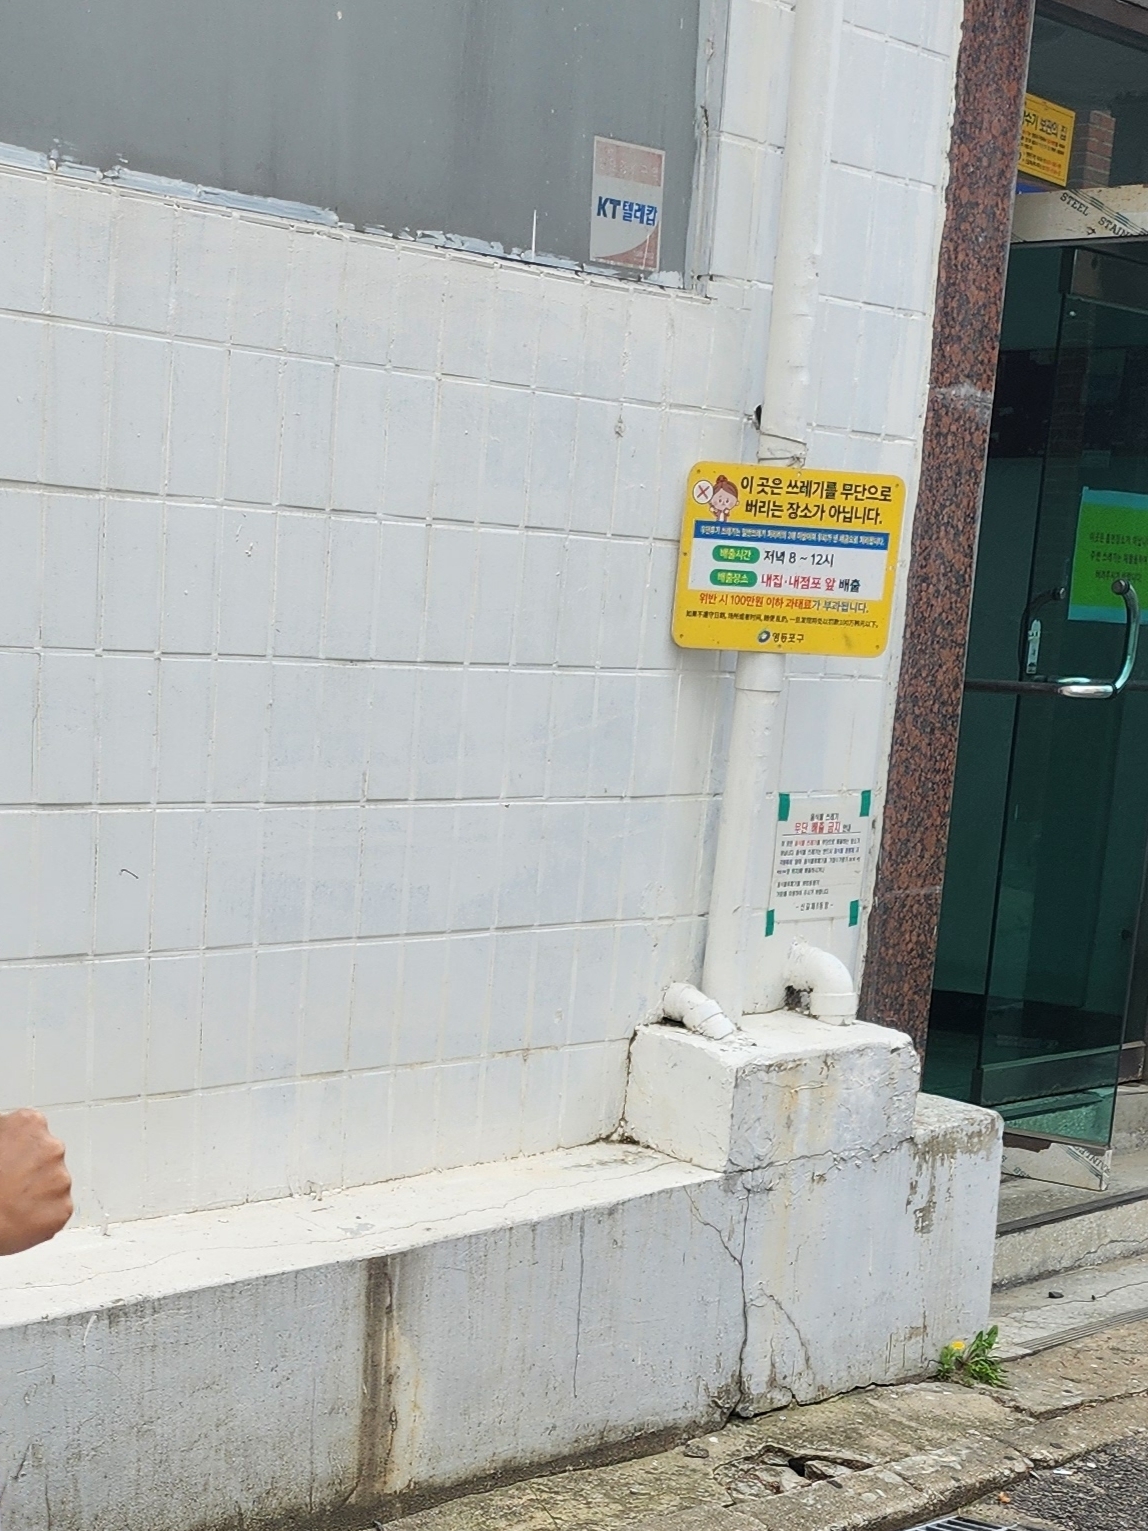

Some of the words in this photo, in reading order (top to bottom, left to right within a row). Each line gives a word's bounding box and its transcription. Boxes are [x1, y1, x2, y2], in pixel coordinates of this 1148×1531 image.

[1060, 192, 1090, 217] STEEL
[741, 476, 754, 491] 이
[757, 477, 783, 495] 곳은
[786, 480, 838, 500] 쓰레기를
[841, 483, 892, 502] 무단으로
[745, 500, 784, 518] 버리는
[787, 502, 825, 521] 장소가
[829, 506, 883, 525] 아닙니다.
[764, 550, 786, 564] 저녁
[789, 552, 796, 563] 8
[811, 553, 834, 567] 12시
[825, 577, 836, 591] 앞
[838, 579, 861, 593] 배출
[699, 593, 718, 606] 위반
[720, 594, 728, 606] 시
[731, 594, 764, 608] 100만원
[766, 597, 784, 610] 이하
[785, 599, 821, 611] 과태료가
[772, 633, 805, 643] 영등포구
